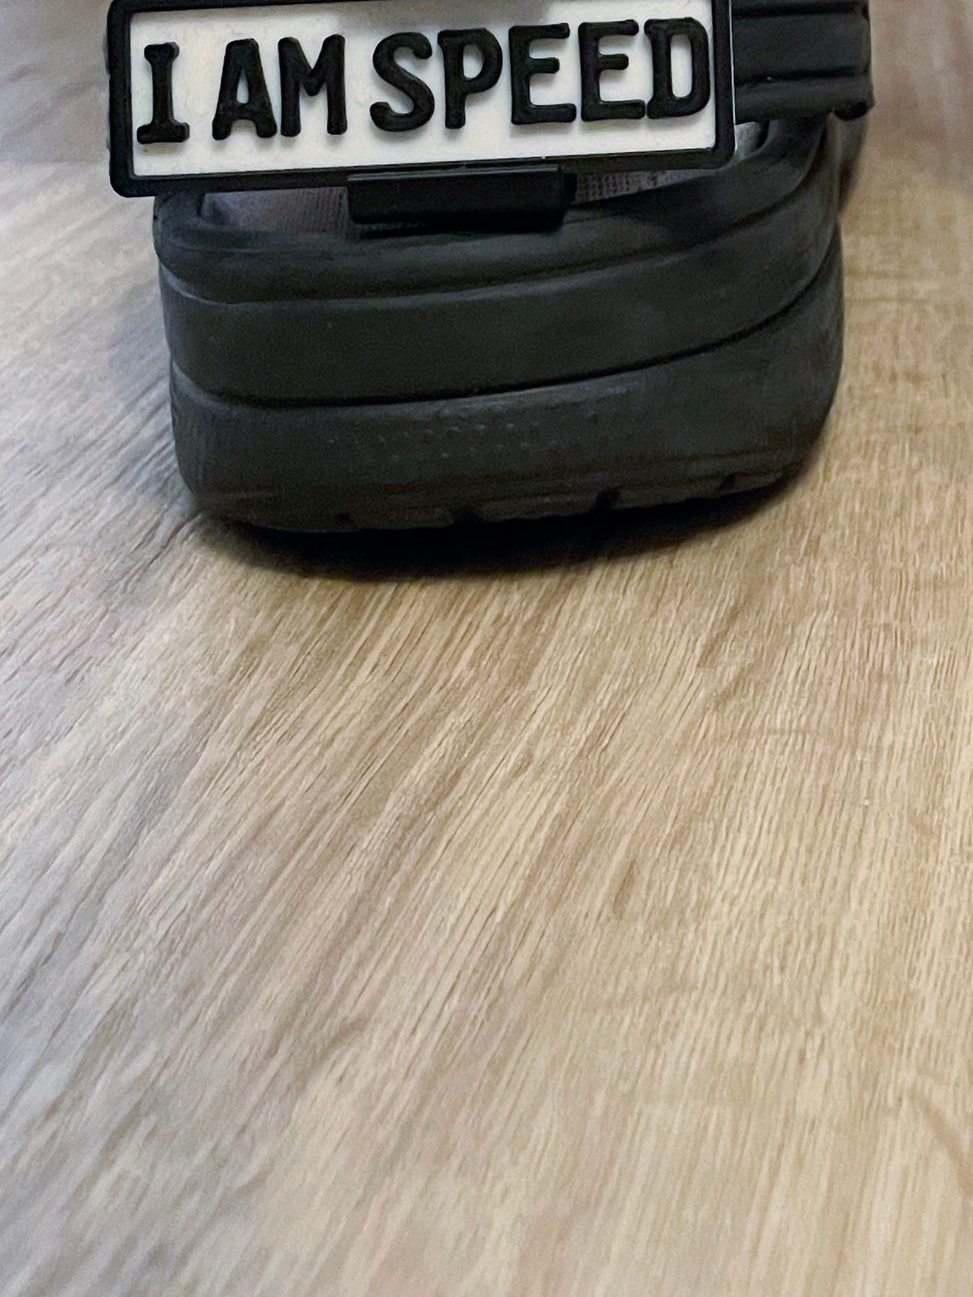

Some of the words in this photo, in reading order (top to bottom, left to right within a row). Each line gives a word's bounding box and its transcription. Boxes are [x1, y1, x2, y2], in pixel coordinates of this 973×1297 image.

[137, 41, 190, 145] I
[211, 34, 348, 141] AM
[369, 16, 713, 133] SPEED
